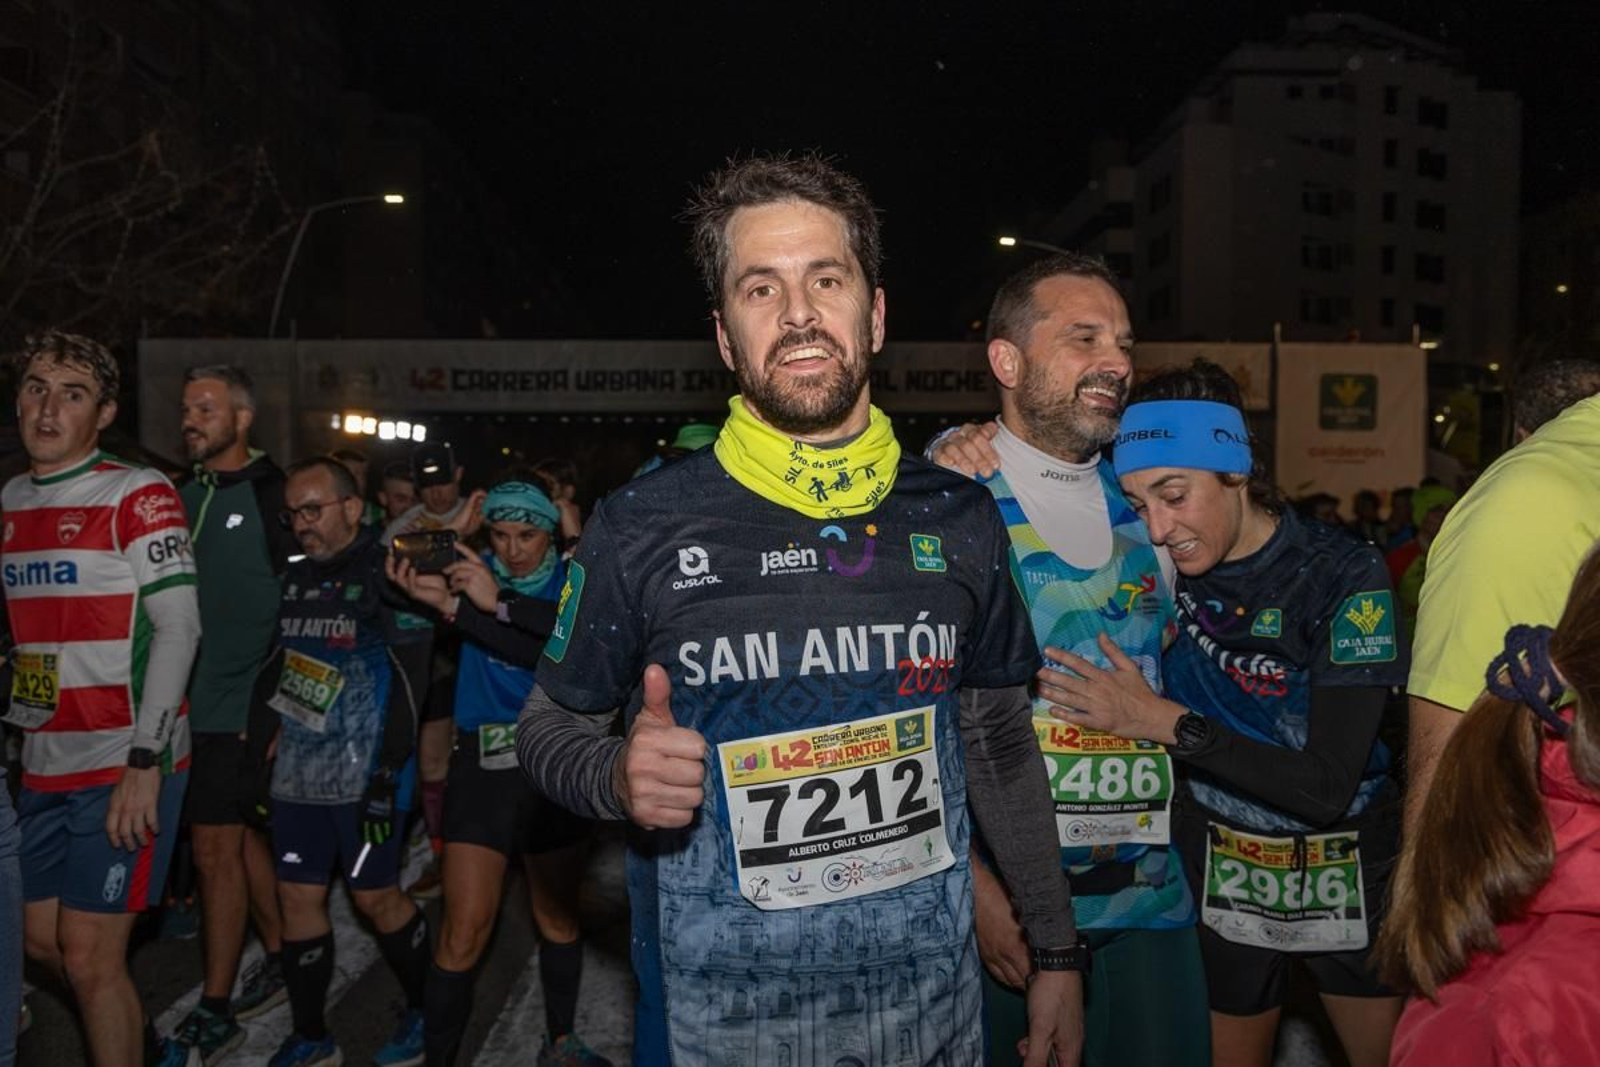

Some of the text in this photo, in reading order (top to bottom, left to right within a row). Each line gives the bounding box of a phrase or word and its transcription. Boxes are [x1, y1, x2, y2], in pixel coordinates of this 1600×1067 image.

[410, 367, 447, 391] 42
[451, 369, 568, 391] CARRERA
[576, 369, 675, 391] URBANA
[905, 370, 987, 392] NOCHE
[812, 460, 825, 469] de
[827, 457, 848, 468] Siles
[678, 611, 957, 687] SAN ANTÓN
[1337, 636, 1392, 649] CAJA RURAL
[282, 669, 330, 705] 2569
[1050, 726, 1081, 749] 42
[771, 739, 814, 771] 42
[814, 747, 843, 765] SAN
[747, 758, 928, 843] 7212
[1055, 803, 1087, 812] ANTONIO
[789, 825, 908, 858] ALBERTO CRUZ COLMENERO
[1236, 839, 1261, 860] 42
[1218, 859, 1348, 909] 2986
